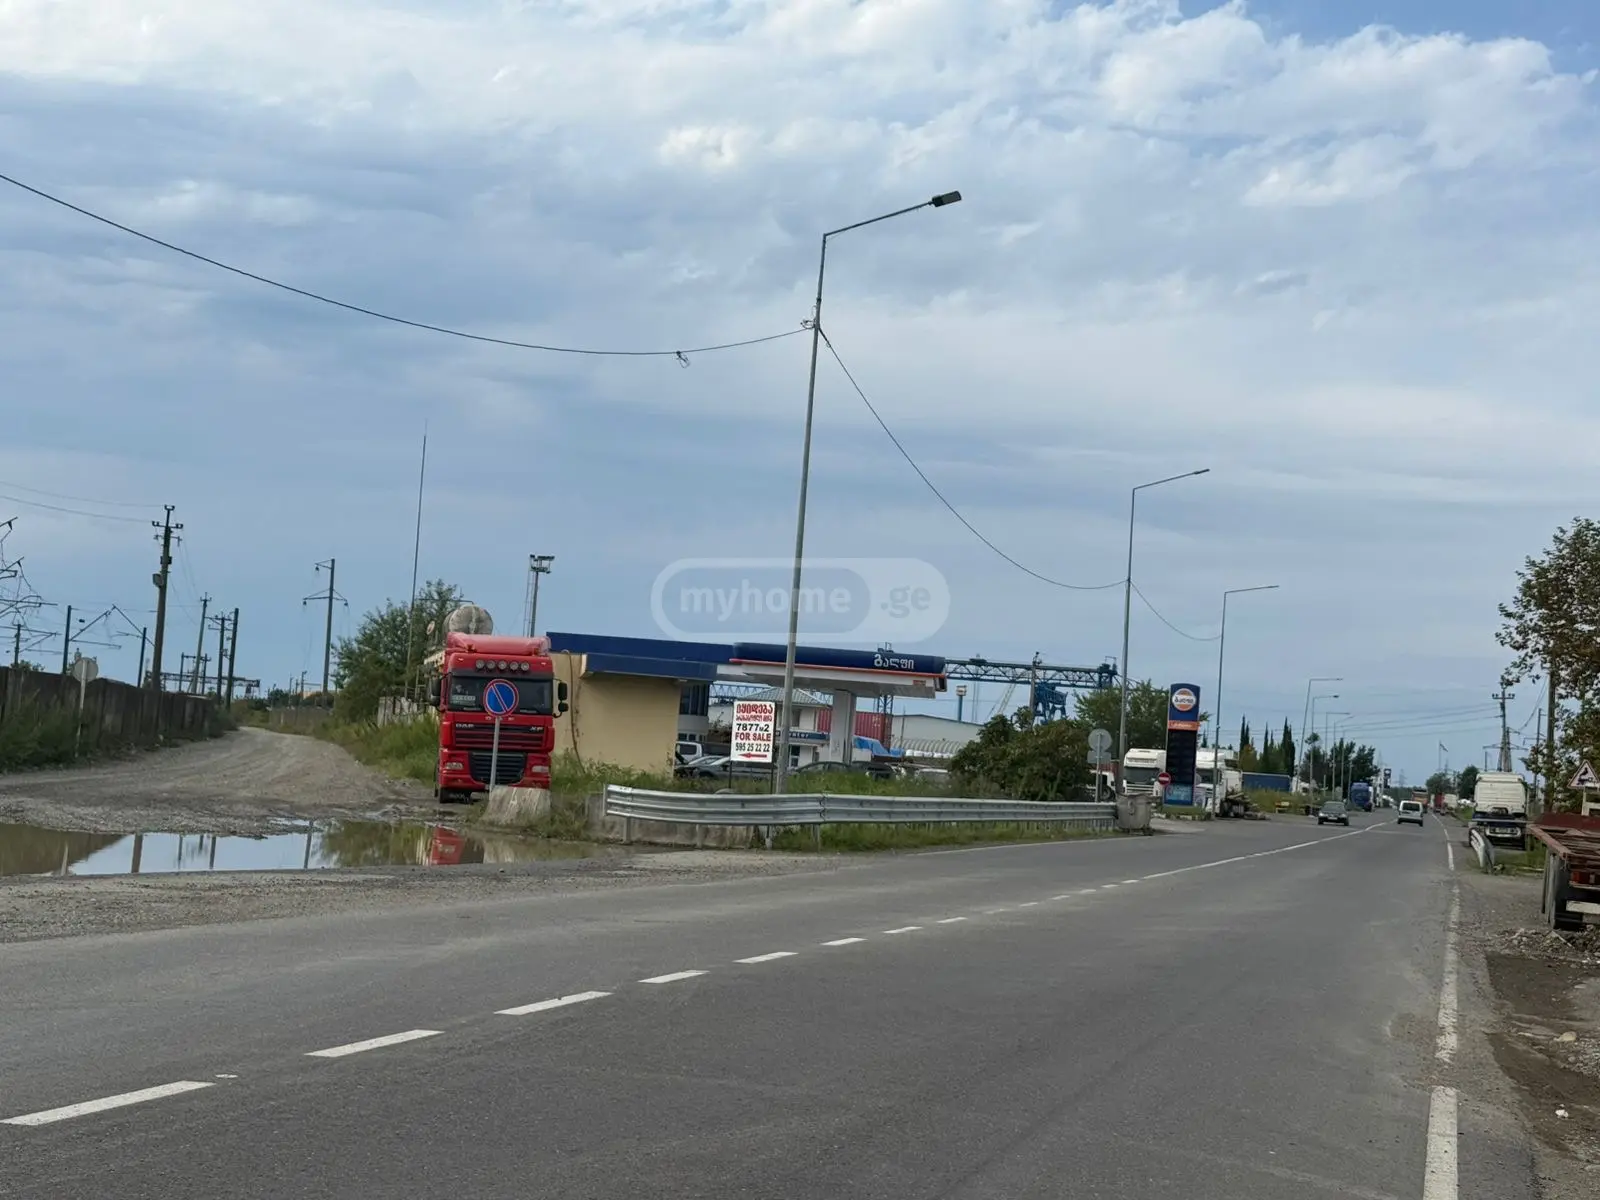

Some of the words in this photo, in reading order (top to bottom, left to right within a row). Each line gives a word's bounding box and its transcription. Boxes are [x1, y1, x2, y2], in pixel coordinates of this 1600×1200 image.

[874, 653, 915, 670] გალფი
[736, 703, 773, 714] იყიდება
[735, 732, 751, 741] FOR
[752, 733, 771, 742] SALE
[735, 743, 746, 751] 595
[747, 743, 754, 752] 25
[755, 744, 761, 752] 22
[763, 744, 770, 752] 22
